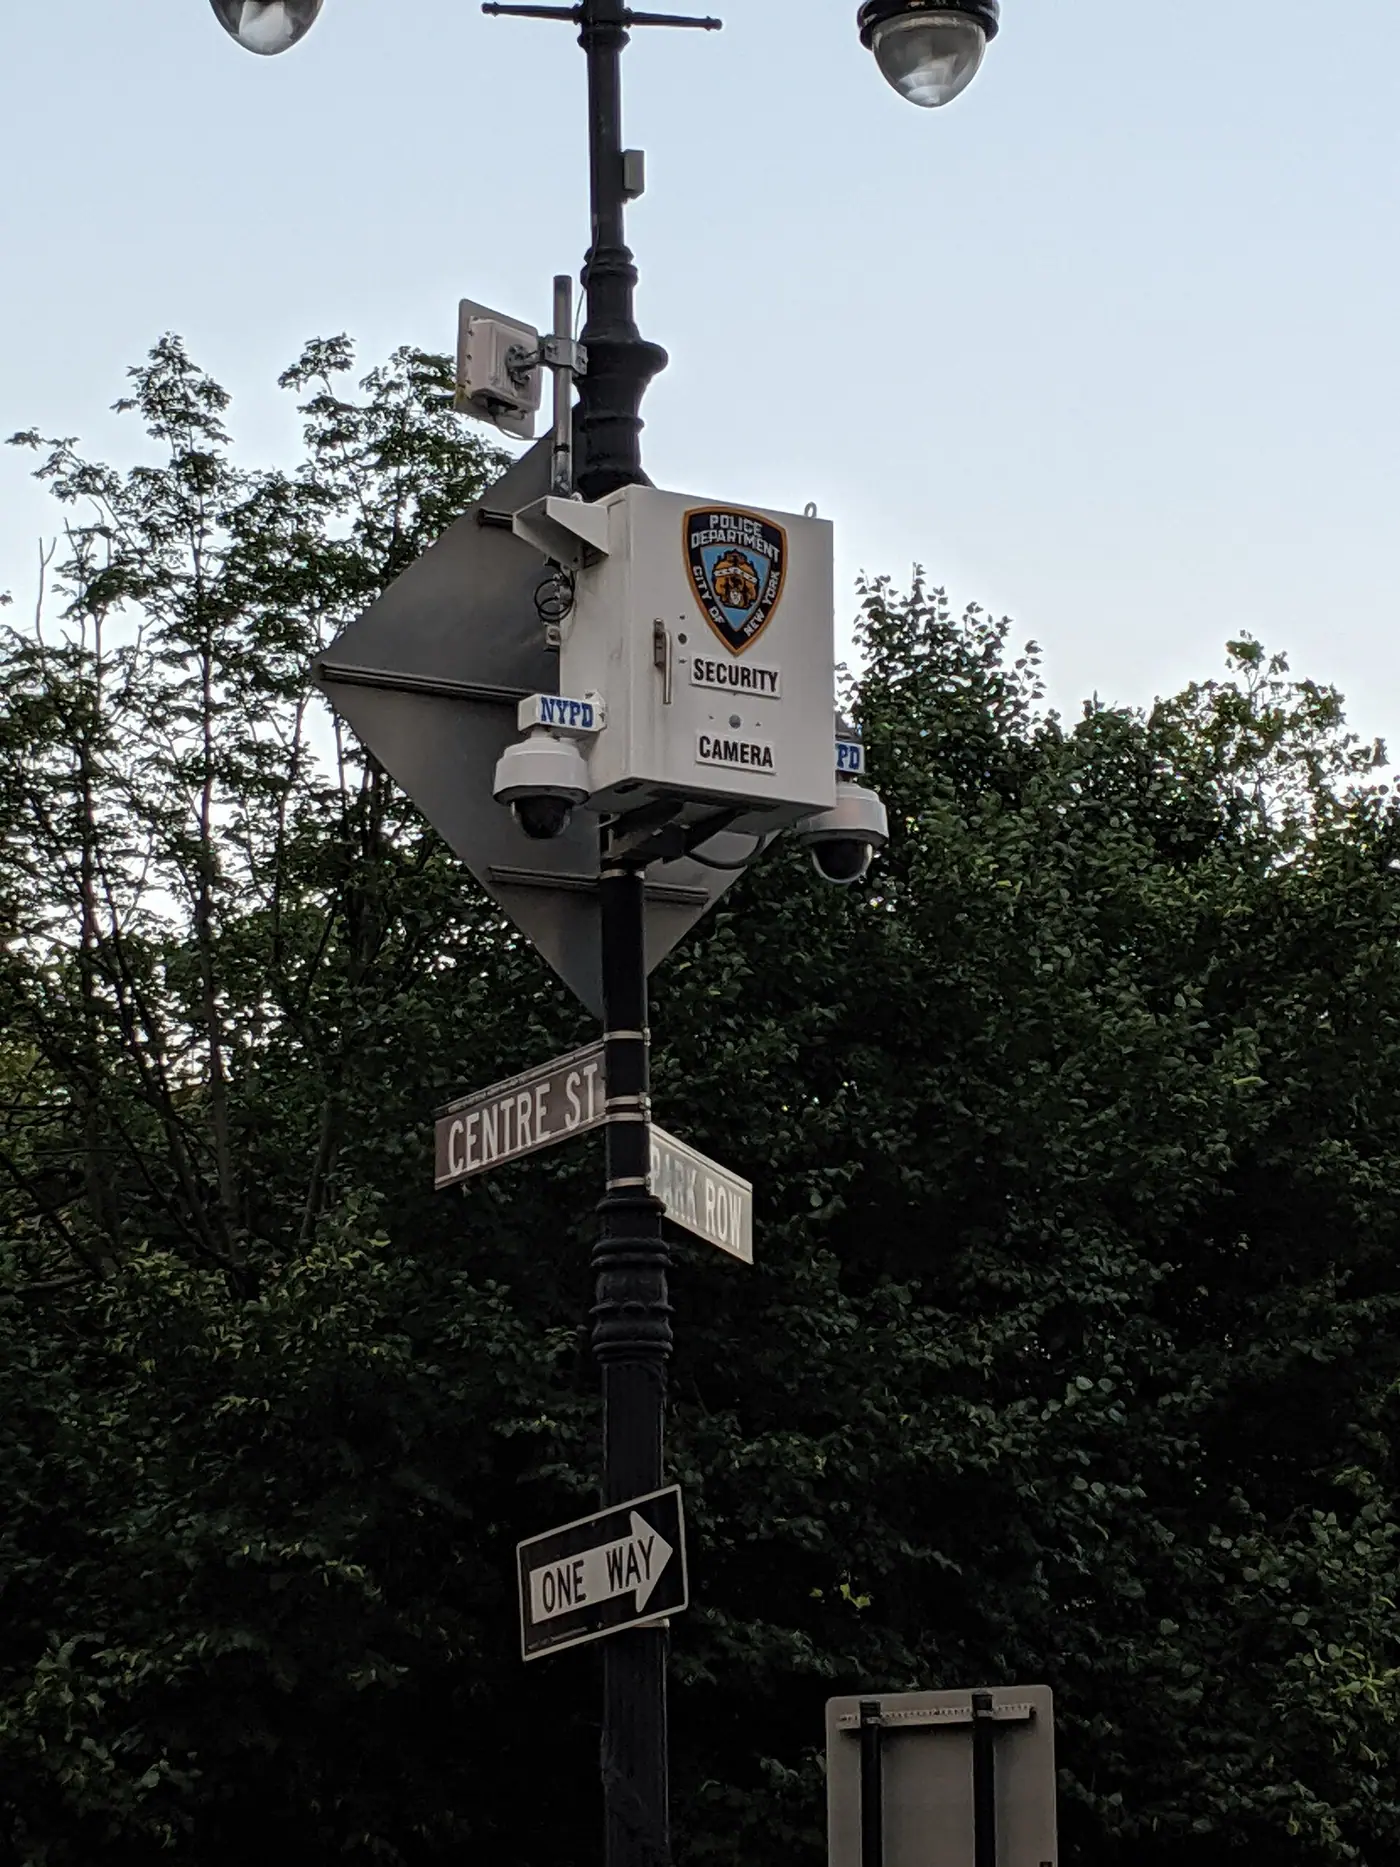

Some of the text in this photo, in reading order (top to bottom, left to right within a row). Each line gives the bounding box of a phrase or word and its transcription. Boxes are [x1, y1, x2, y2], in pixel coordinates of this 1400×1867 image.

[709, 515, 763, 538] POLICE
[691, 530, 780, 562] DEPARTMENT
[693, 565, 725, 624] CITY OF
[743, 570, 780, 637] NEW YORK
[693, 658, 778, 692] SECURITY
[540, 696, 594, 728] NYPD
[699, 735, 773, 768] CAMERA
[836, 743, 860, 770] PD
[448, 1063, 598, 1177] CENTRE ST
[705, 1178, 742, 1250] ROW
[542, 1535, 655, 1613] ONE WAY
